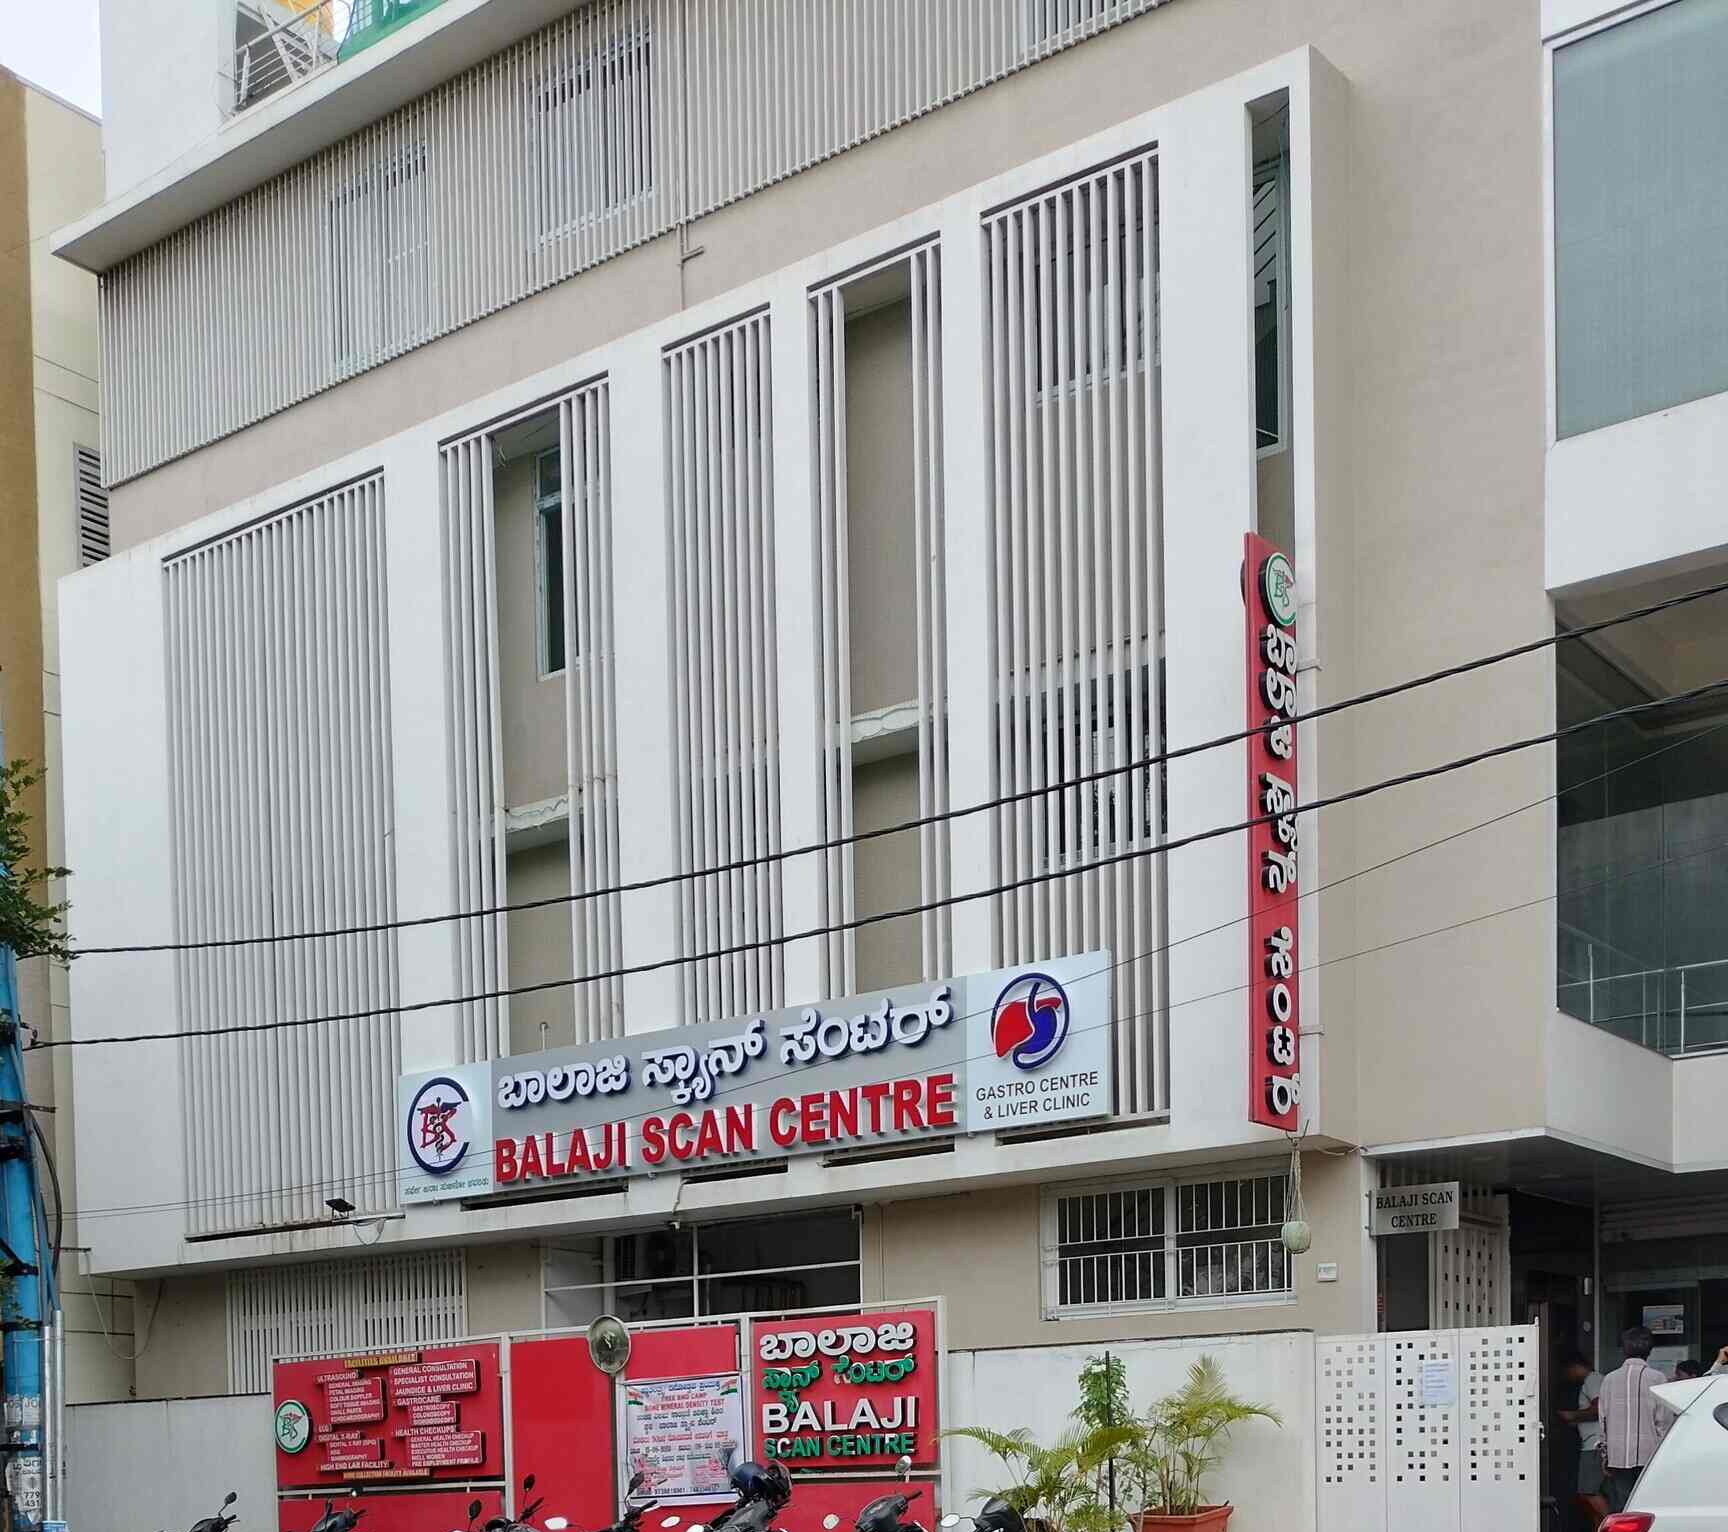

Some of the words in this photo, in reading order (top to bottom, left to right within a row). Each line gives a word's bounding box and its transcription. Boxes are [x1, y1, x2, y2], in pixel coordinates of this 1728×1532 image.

[498, 1054, 630, 1110] ಬಾಲಾಜಿ
[641, 1018, 768, 1105] ಸ್ಕ್ಯಾನ್
[780, 985, 954, 1065] ಸೆಂಟರ್
[976, 1080, 1036, 1101] GASTRO
[1040, 1071, 1099, 1094] CENTRE
[984, 1105, 993, 1120] &
[998, 1099, 1039, 1119] LIVER
[1044, 1092, 1091, 1112] CLINIC
[495, 1120, 631, 1186] BALAJI
[641, 1102, 759, 1166] SCAN
[769, 1071, 957, 1147] CENTRE
[1376, 1194, 1418, 1209] BALAJI
[1422, 1191, 1454, 1205] SCAN
[1391, 1213, 1437, 1228] CENTRE
[760, 1321, 914, 1361] ಬಾಲಾಜಿ
[393, 1366, 421, 1375] GENERAL
[422, 1362, 467, 1372] CONSULTATION
[394, 1376, 428, 1385] SPECIALIST
[429, 1372, 474, 1382] CONSULTATION
[433, 1384, 451, 1392] LIVER
[452, 1382, 473, 1390] CLINIC
[762, 1396, 917, 1433] BALAJI
[396, 1428, 419, 1437] HEALTH
[764, 1436, 821, 1458] SCAN
[827, 1432, 916, 1455] CENTRE
